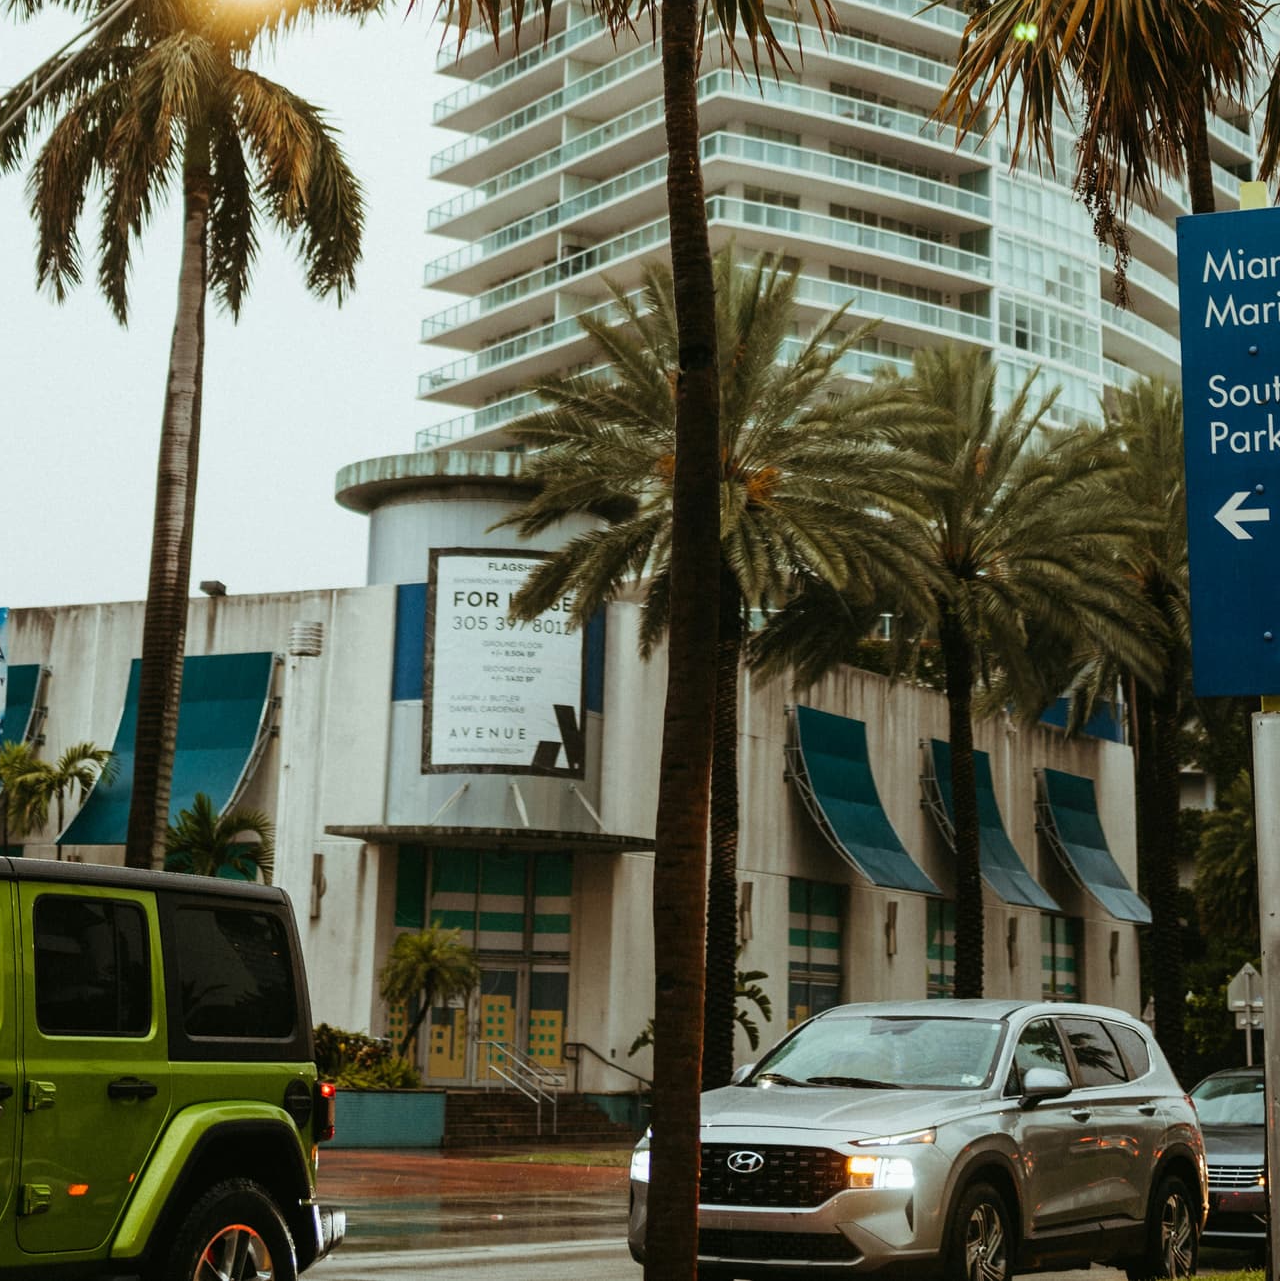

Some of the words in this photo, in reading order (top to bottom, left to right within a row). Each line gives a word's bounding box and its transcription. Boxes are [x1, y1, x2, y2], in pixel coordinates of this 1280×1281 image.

[453, 591, 499, 608] FOR
[452, 616, 489, 630] 305
[448, 727, 527, 740] AVENUE
